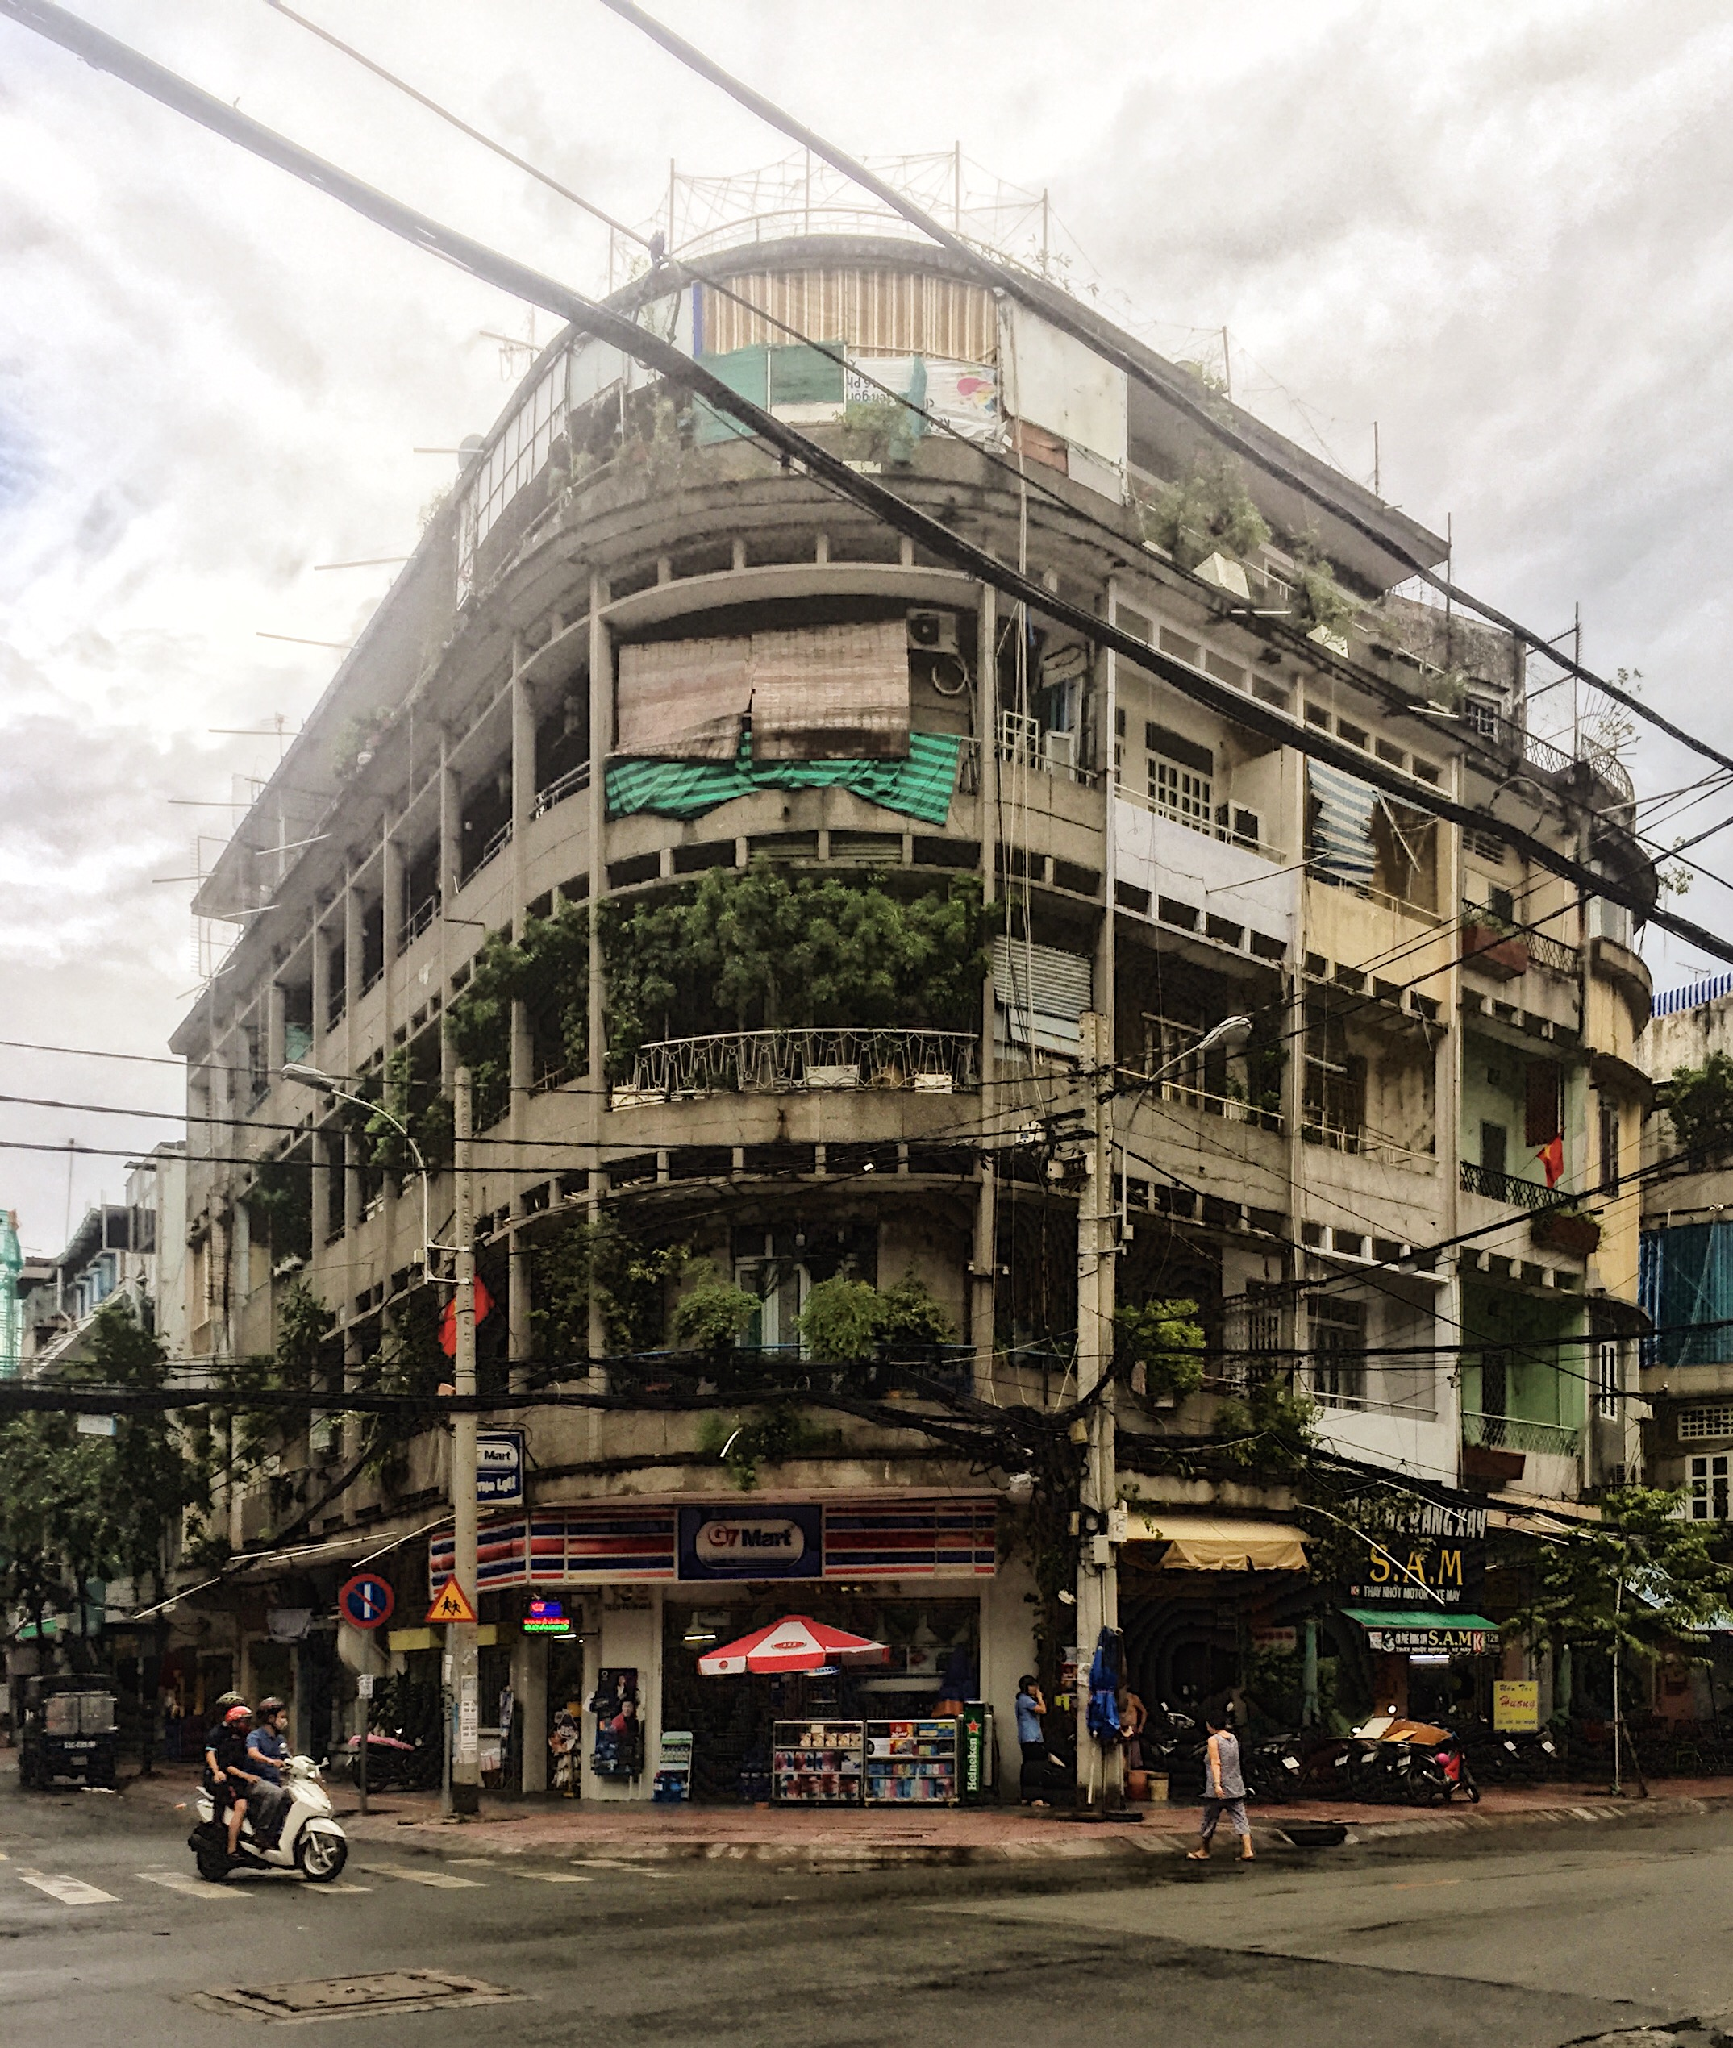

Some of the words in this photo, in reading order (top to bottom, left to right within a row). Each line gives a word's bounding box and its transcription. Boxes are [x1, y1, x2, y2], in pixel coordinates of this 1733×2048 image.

[484, 1450, 511, 1460] Mart
[708, 1523, 739, 1547] G7
[741, 1529, 791, 1547] Mart
[1369, 1544, 1463, 1586] S.A.M
[1428, 1629, 1472, 1647] S.A.M
[967, 1737, 978, 1792] Heineken
